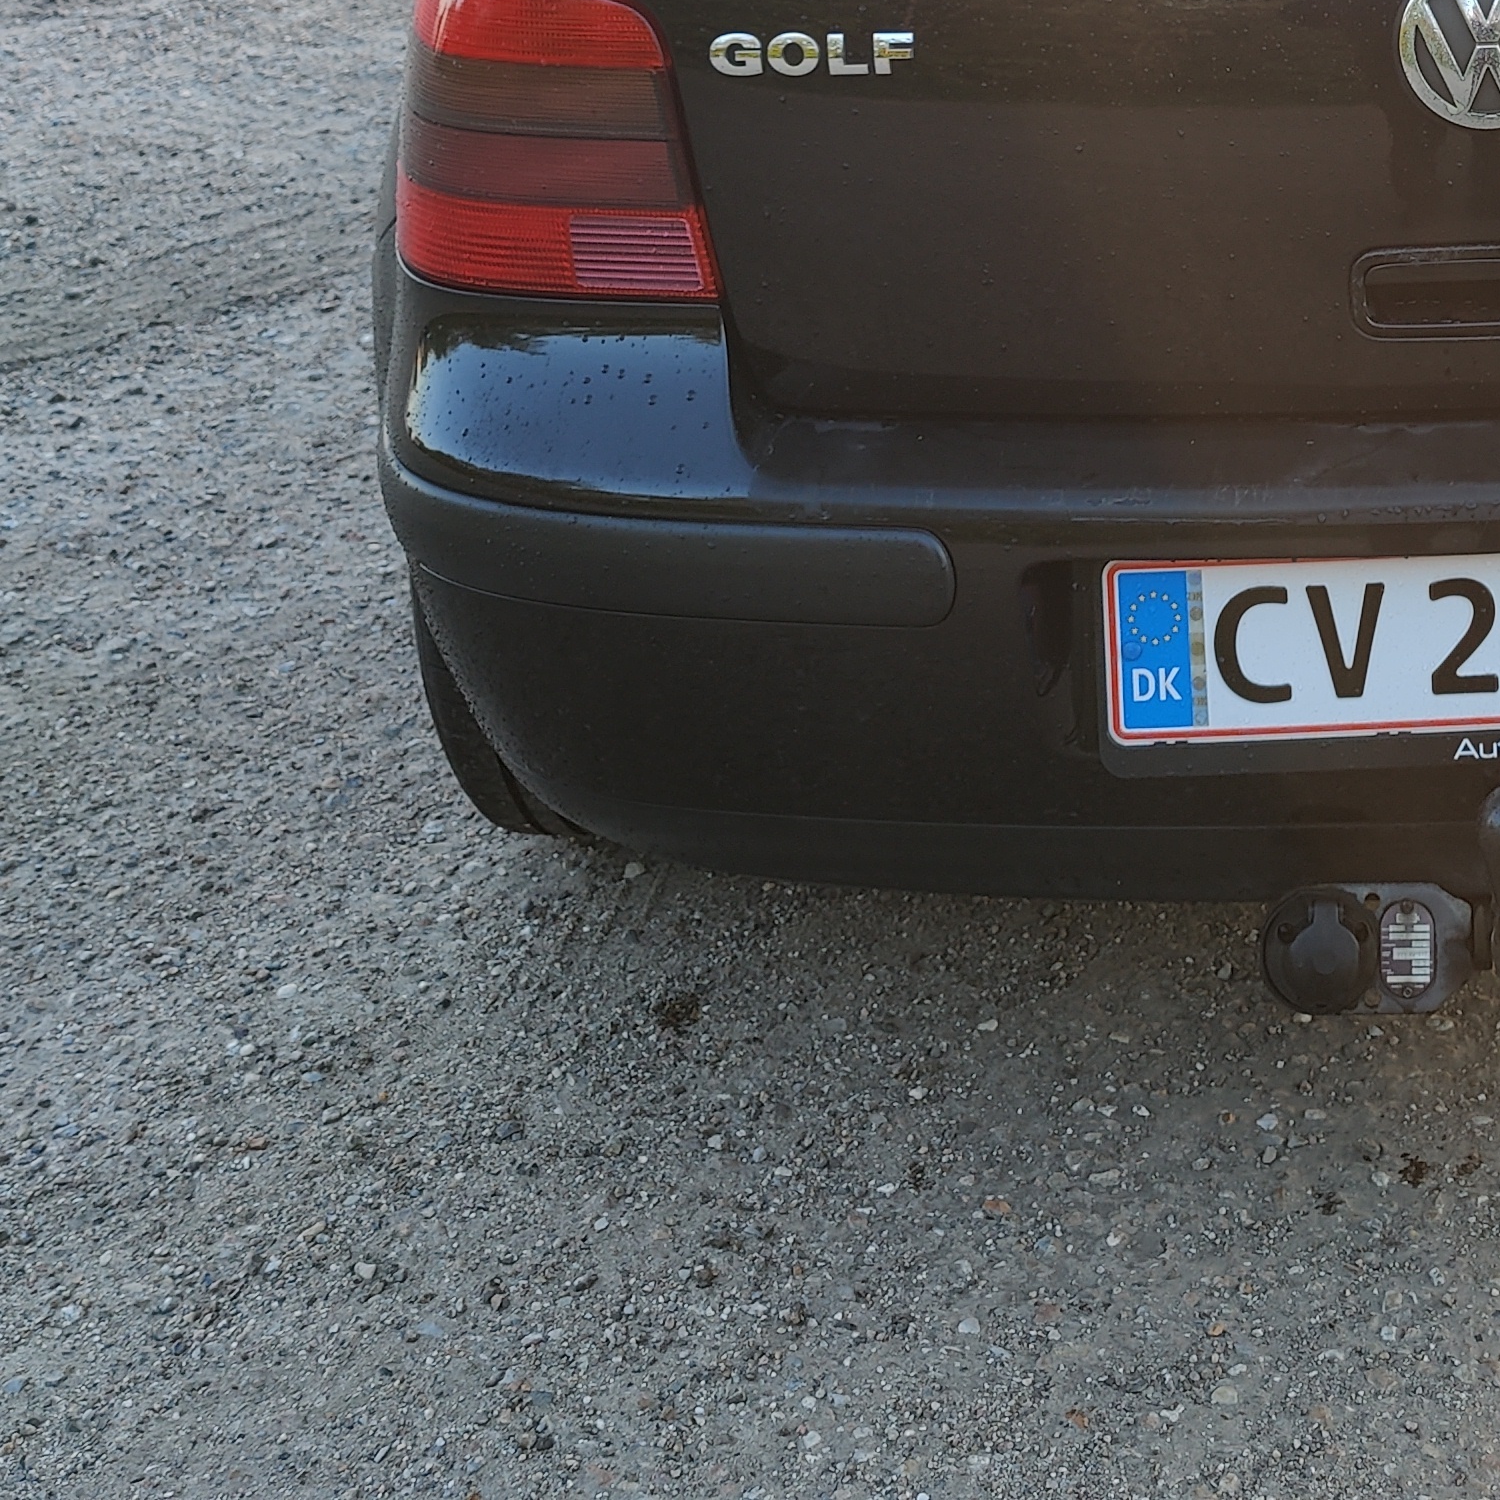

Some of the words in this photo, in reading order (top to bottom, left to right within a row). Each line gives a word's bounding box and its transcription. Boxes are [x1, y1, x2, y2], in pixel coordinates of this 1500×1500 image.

[708, 31, 916, 77] GOLF
[1212, 582, 1385, 703] CV
[1131, 665, 1183, 703] DK
